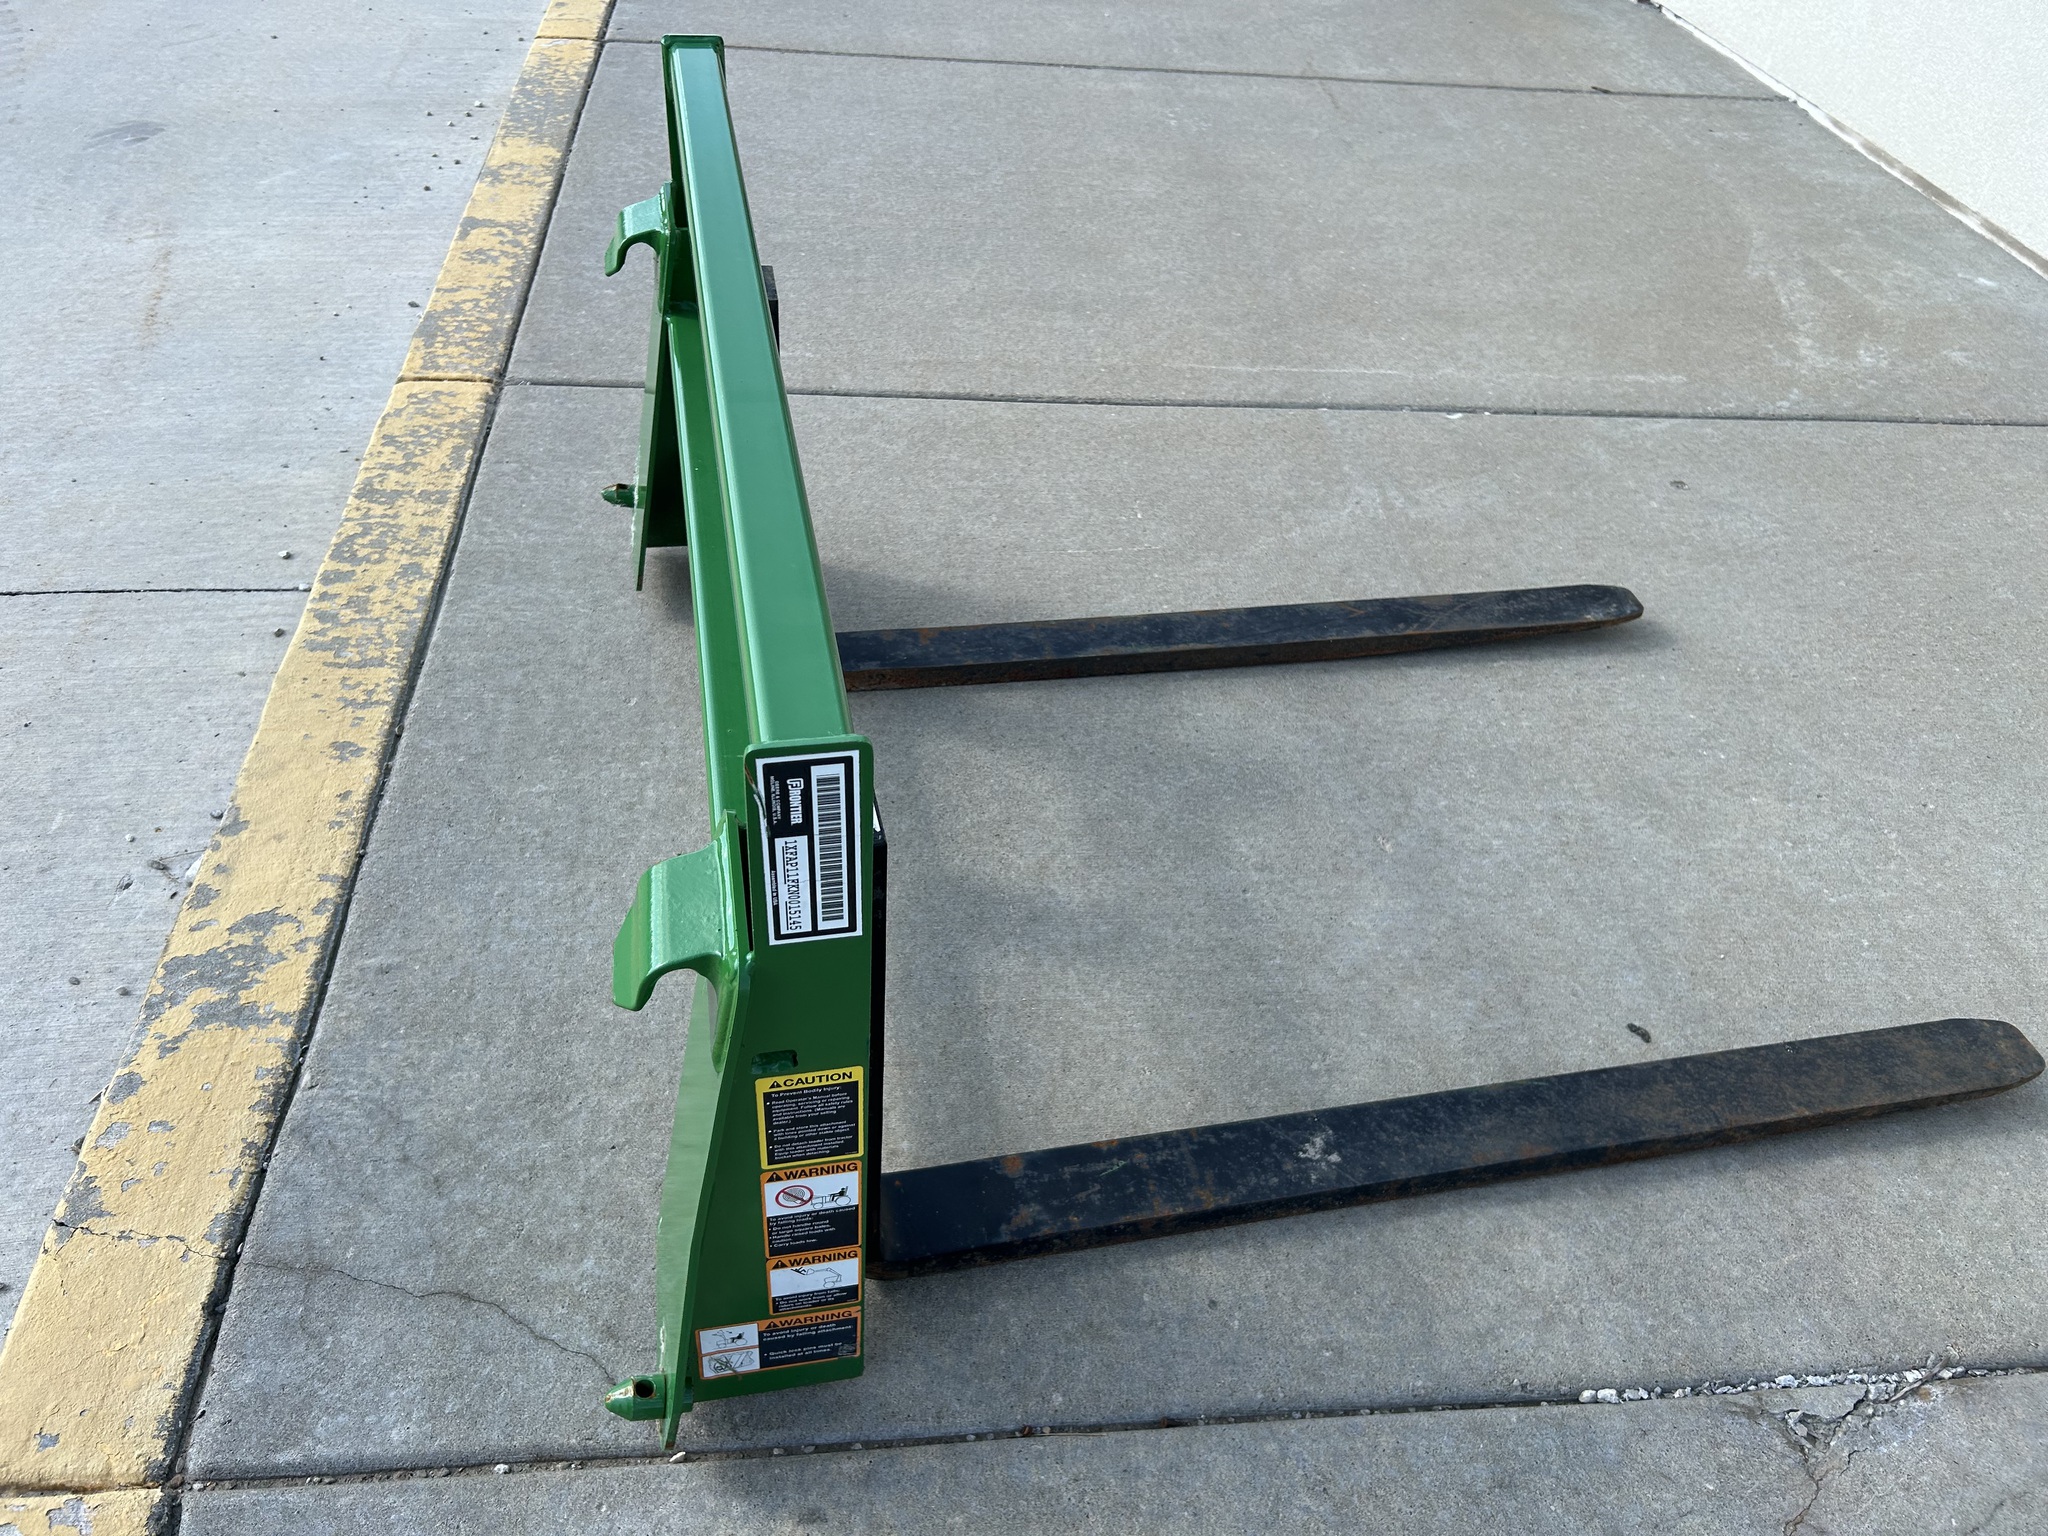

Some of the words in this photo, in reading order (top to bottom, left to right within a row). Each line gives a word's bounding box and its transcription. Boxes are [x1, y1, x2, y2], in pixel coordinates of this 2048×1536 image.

[786, 778, 804, 826] FRONTIER
[784, 840, 802, 931] 1XFAP11FKN0015145
[784, 1072, 852, 1087] CAUTION
[784, 1163, 858, 1180] WARNING
[789, 1250, 858, 1267] WARNING
[779, 1311, 852, 1326] WARNING
